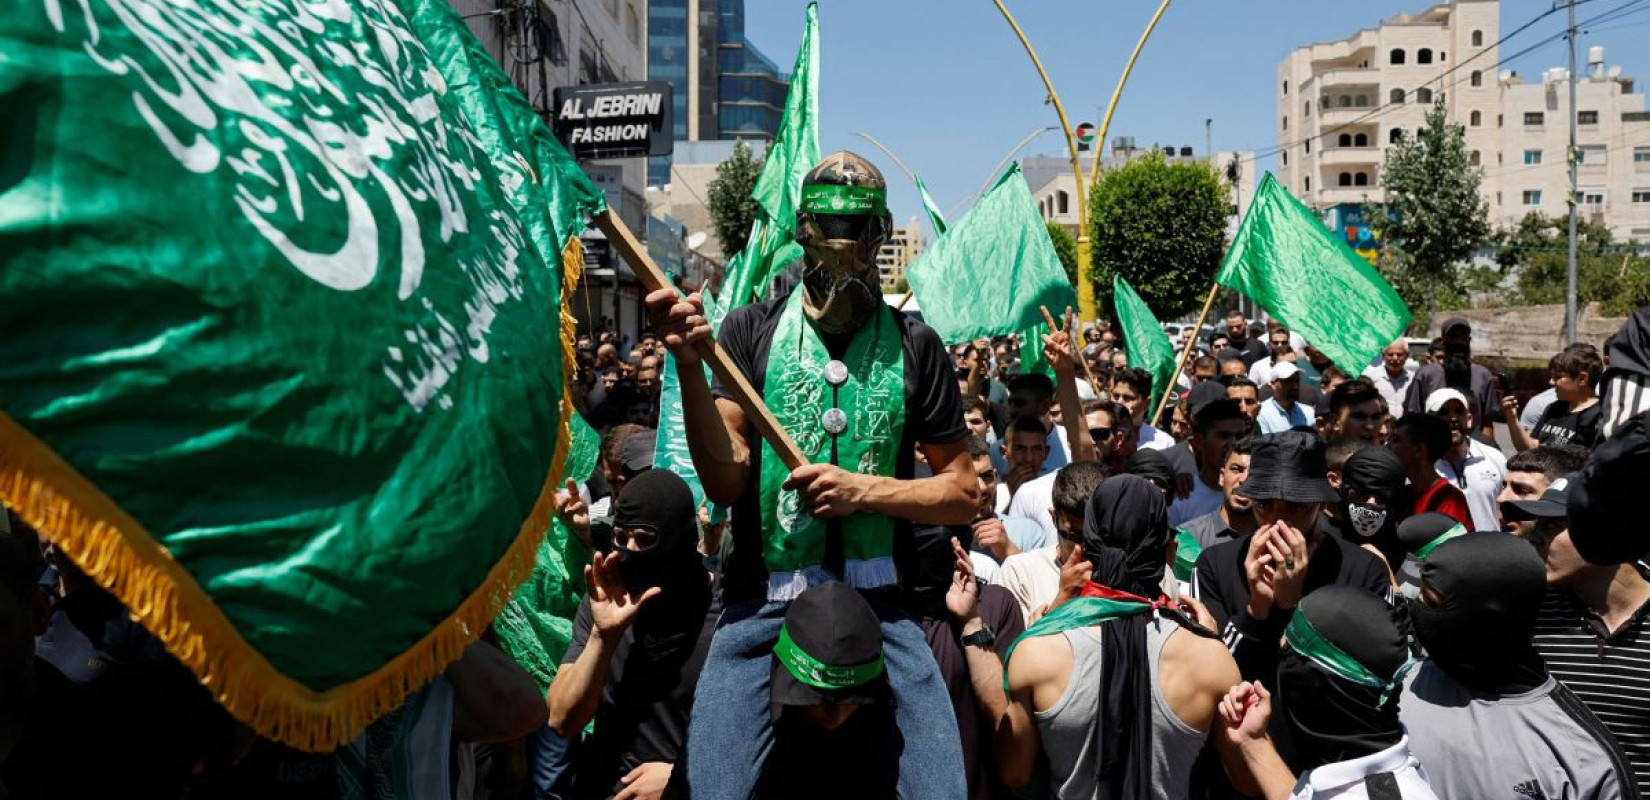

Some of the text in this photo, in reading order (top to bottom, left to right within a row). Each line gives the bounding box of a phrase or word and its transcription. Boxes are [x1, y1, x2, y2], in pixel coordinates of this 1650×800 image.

[560, 93, 662, 120] AL JEBRINI
[571, 124, 648, 144] FASHION
